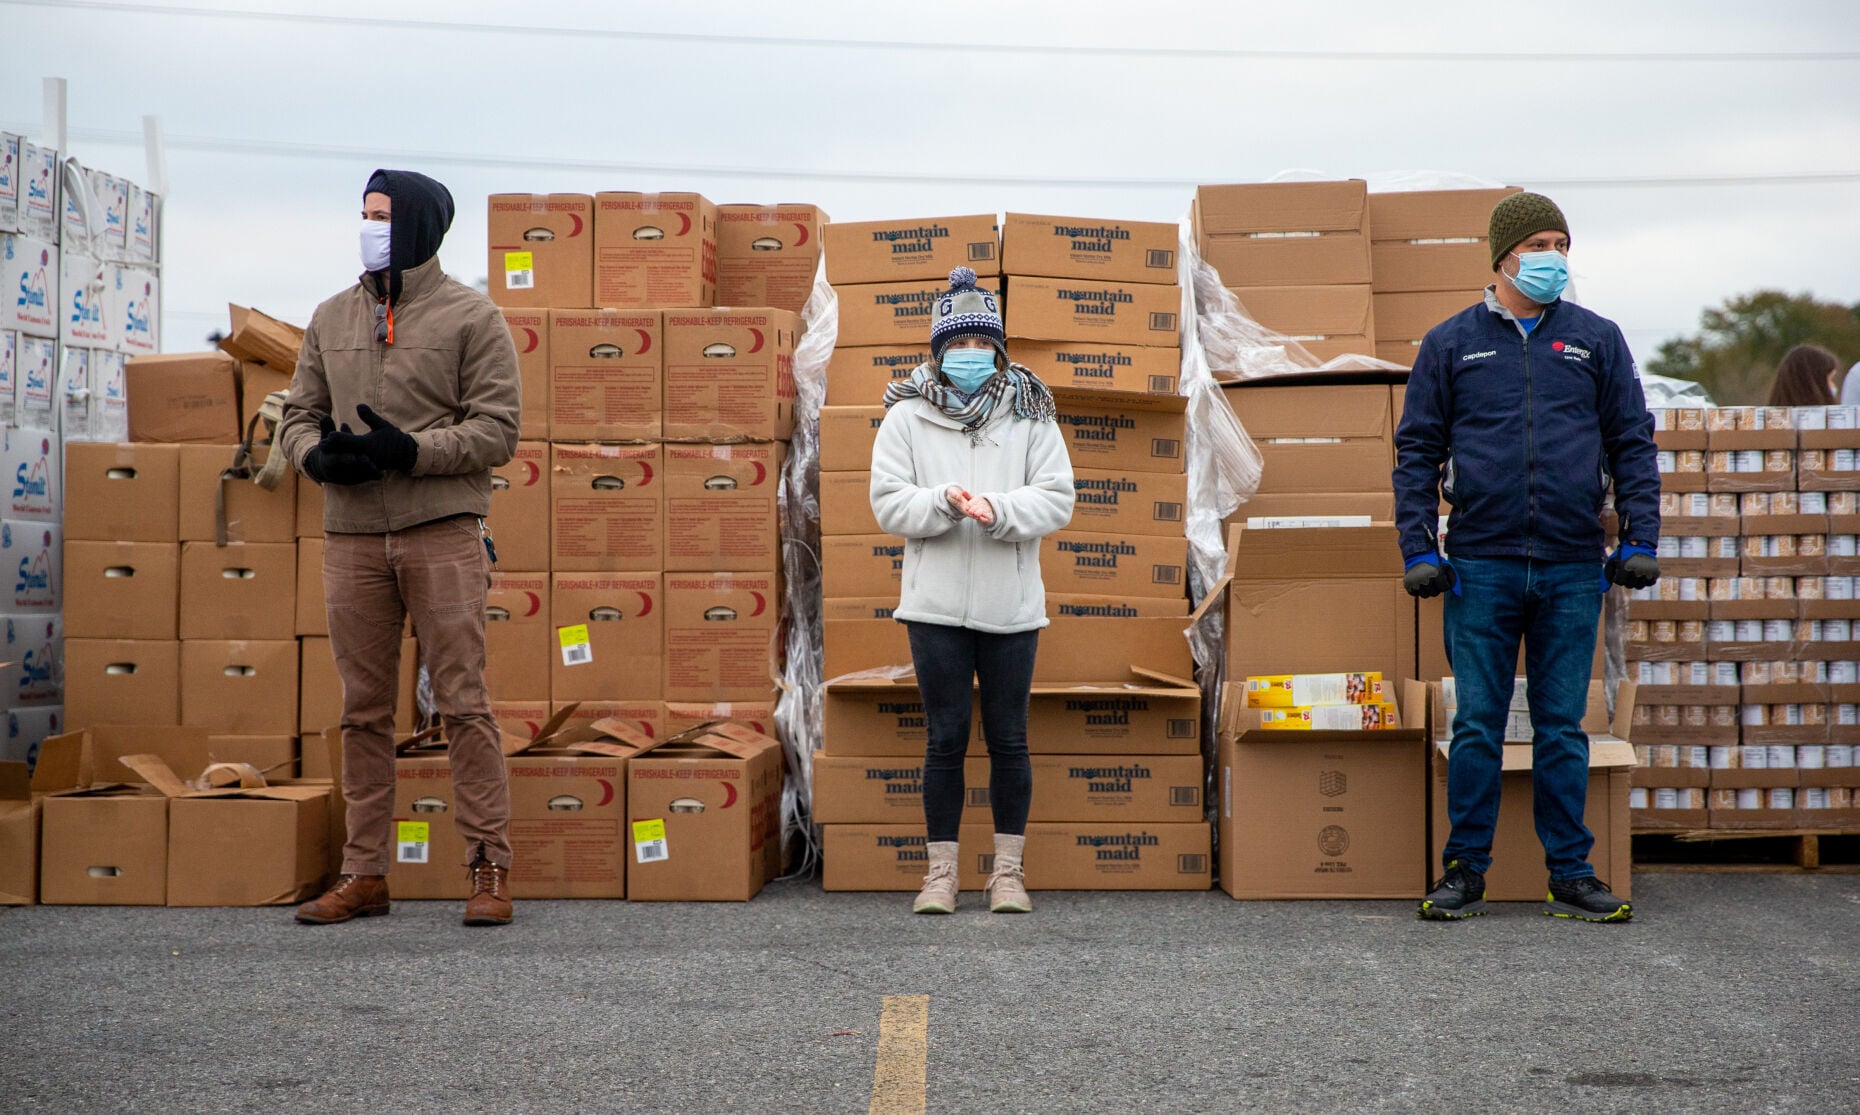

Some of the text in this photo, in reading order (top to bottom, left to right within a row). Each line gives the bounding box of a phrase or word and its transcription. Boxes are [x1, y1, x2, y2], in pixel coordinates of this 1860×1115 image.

[872, 224, 950, 241] mountain
[1054, 225, 1130, 240] mountain
[892, 239, 933, 254] maid
[1071, 239, 1112, 252] maid
[875, 288, 942, 305] mountai
[1057, 289, 1133, 303] mountain
[894, 301, 933, 317] maid
[940, 299, 952, 317] G
[984, 297, 996, 313] G
[1075, 302, 1115, 315] maid
[504, 316, 541, 326] FRIGERATED
[556, 317, 654, 327] PERISHABLE-KEEP REFRIGERATED
[668, 316, 767, 326] PERISHABLE-KEEP REFRIGERATED
[1056, 352, 1131, 366] mountain
[1073, 365, 1114, 378] maid
[1057, 414, 1135, 429] mountain
[1074, 427, 1116, 441] maid
[515, 450, 542, 459] GERATED
[1074, 478, 1138, 492] ountain
[1077, 491, 1118, 504] maid
[1057, 541, 1136, 555] mountain
[1075, 554, 1117, 568] maid
[557, 580, 655, 589] PERISHABLE-KEEP REFRIGERATED
[1059, 604, 1138, 617] mountain
[878, 702, 924, 714] moun
[1066, 696, 1149, 711] mountain
[898, 717, 923, 727] ma
[1086, 711, 1130, 725] maid
[511, 767, 617, 777] PERISHABLE-KEEP REFRIGERATED
[634, 769, 740, 779] PERISHABLE-KEEP REFRIGERATED
[866, 767, 921, 780] mount
[1069, 764, 1152, 779] mountain
[1088, 779, 1132, 793] maid
[877, 836, 926, 848] moun
[1077, 832, 1159, 847] mountain
[897, 847, 928, 860] mai
[1096, 846, 1140, 860] maid
